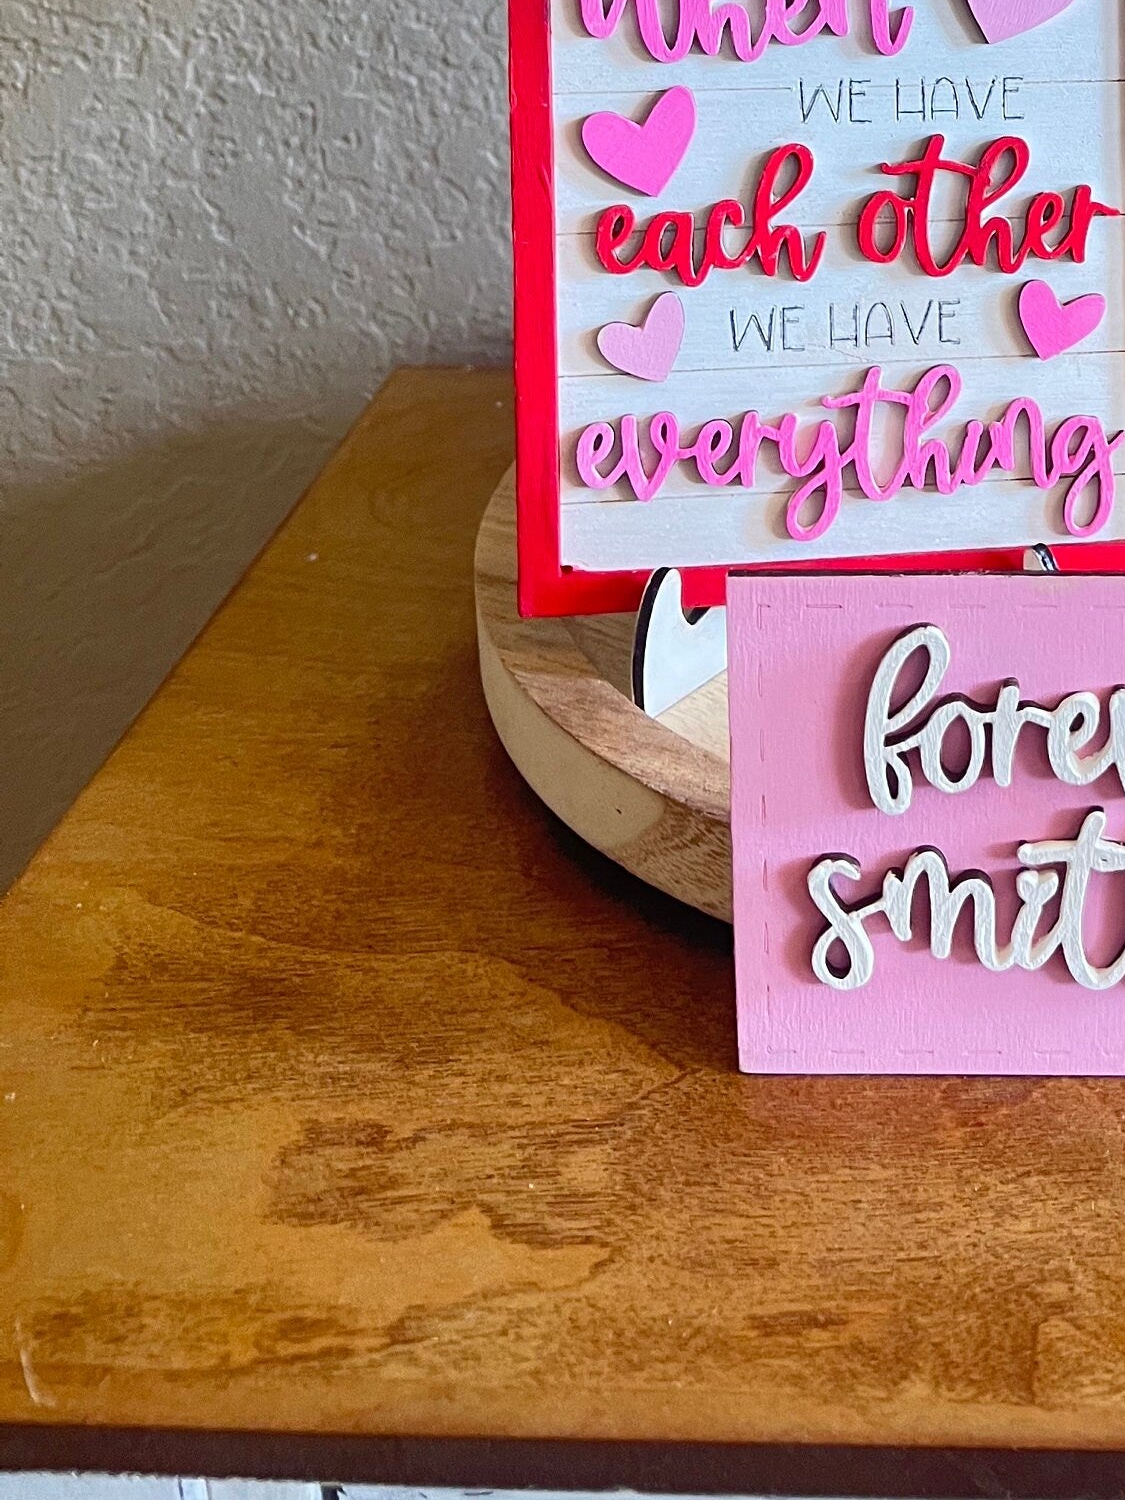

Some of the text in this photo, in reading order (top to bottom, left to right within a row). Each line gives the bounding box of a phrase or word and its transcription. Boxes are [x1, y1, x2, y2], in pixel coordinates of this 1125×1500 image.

[799, 76, 1026, 124] WE HAVE
[595, 133, 1121, 288] each other
[729, 299, 962, 353] WE HAVE
[575, 364, 1125, 542] everything
